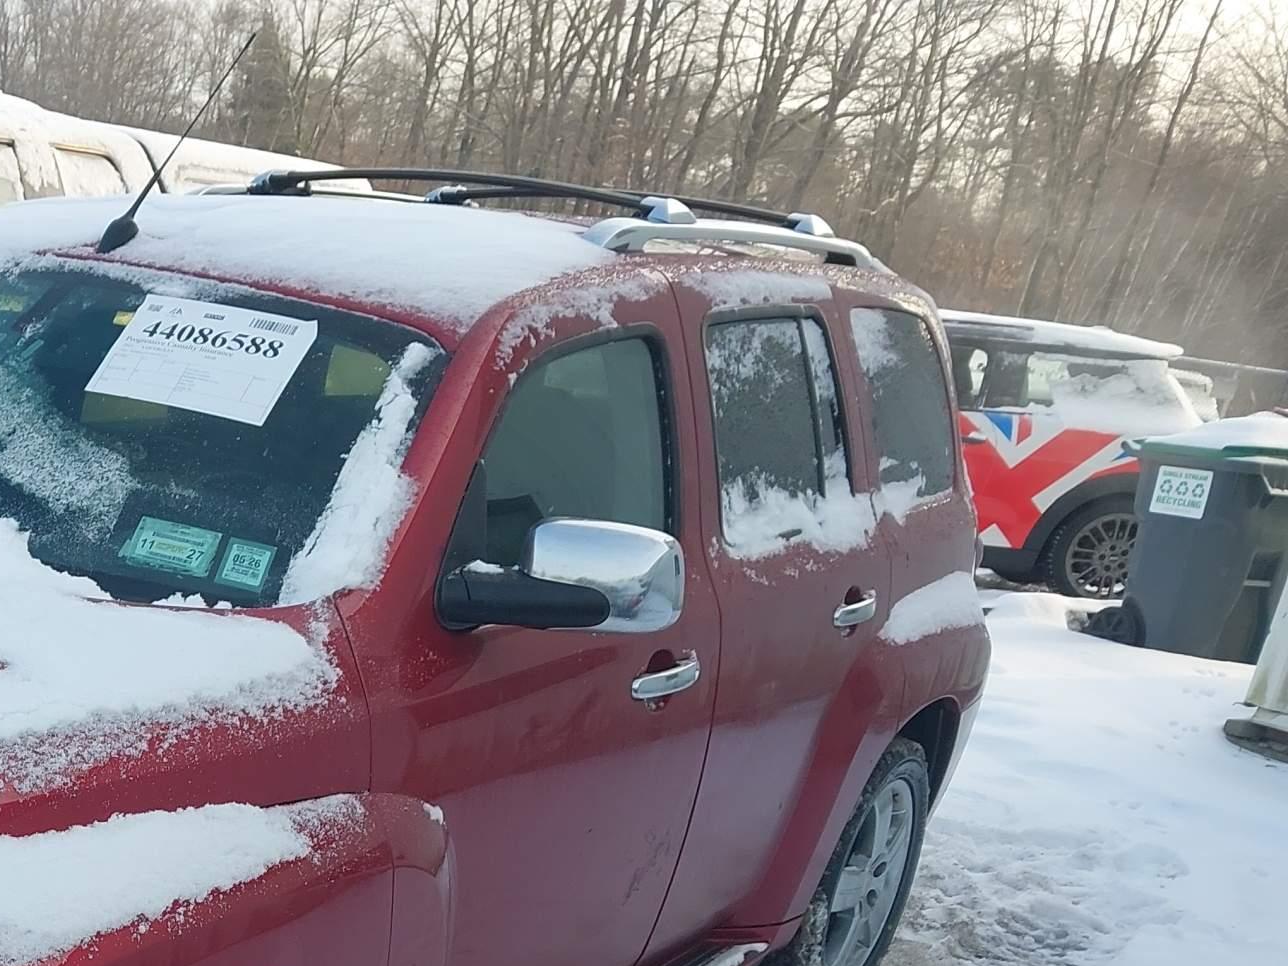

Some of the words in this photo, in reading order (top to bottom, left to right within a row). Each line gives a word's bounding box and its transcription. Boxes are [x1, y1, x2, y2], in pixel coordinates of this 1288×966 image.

[142, 320, 285, 359] 44086588
[1156, 495, 1204, 509] RECYCLING
[140, 538, 156, 550] 11
[185, 548, 205, 561] 27
